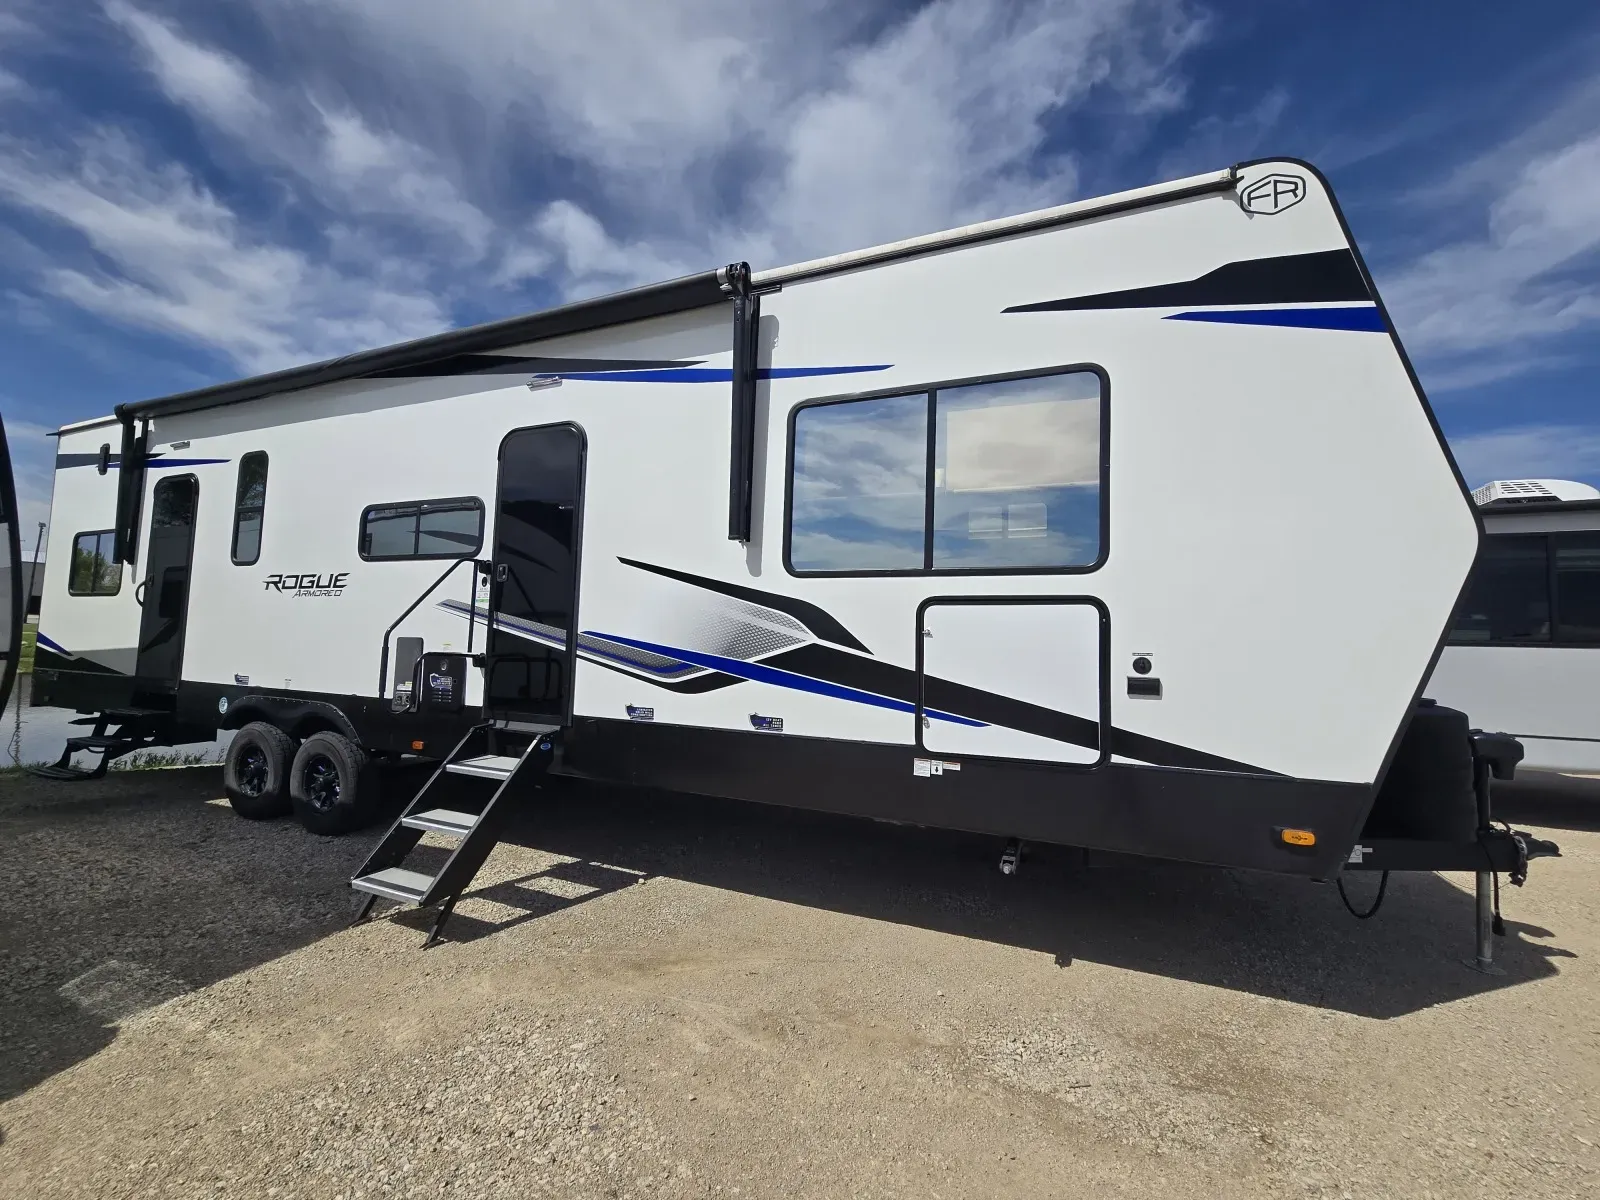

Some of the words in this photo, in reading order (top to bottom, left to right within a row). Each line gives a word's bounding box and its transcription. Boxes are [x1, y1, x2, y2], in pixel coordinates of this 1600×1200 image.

[1247, 179, 1299, 209] FR
[262, 572, 351, 594] ROGUE
[292, 589, 343, 599] ARMORED
